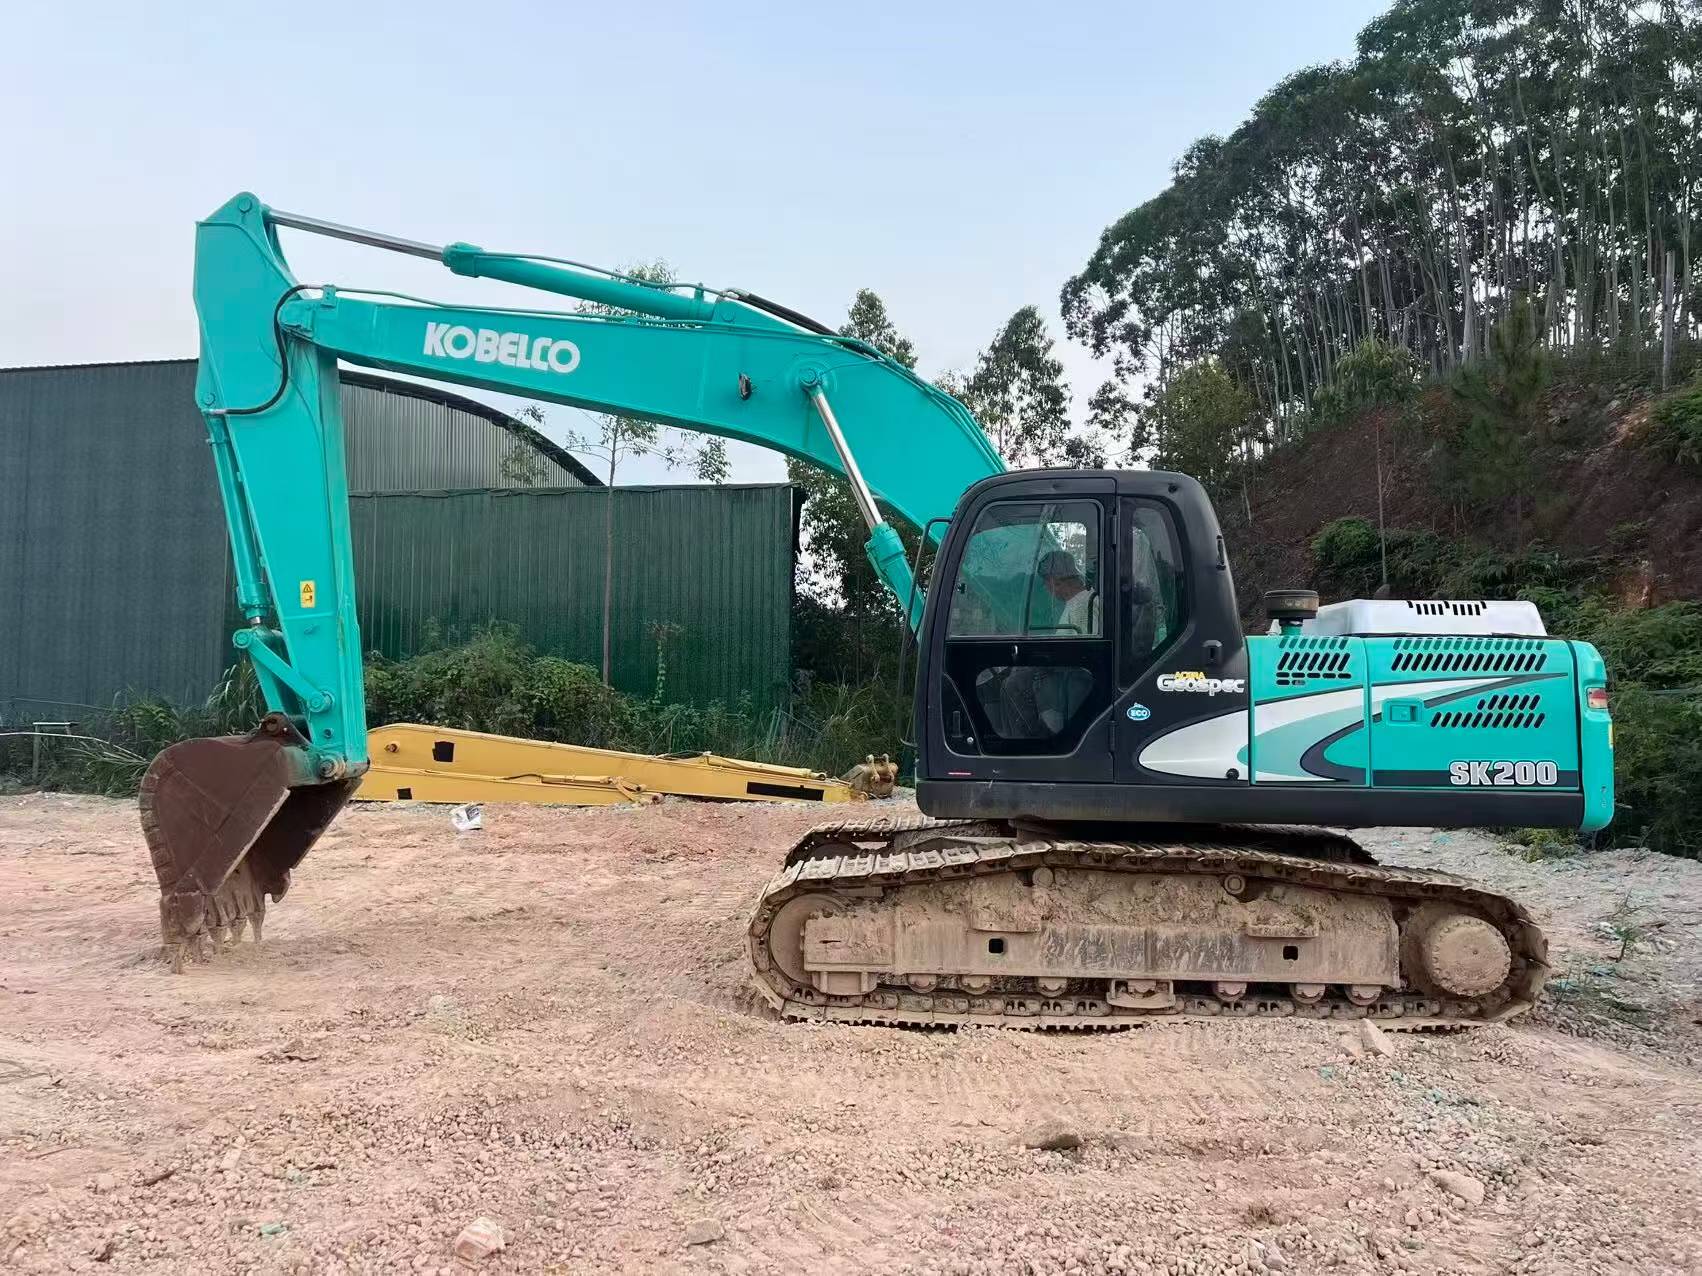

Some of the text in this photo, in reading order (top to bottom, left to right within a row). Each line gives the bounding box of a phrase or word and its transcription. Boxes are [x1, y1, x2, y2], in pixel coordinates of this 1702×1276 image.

[423, 321, 581, 373] KOBELCO
[1156, 674, 1245, 696] Geospec
[1130, 709, 1148, 717] ECO
[1449, 761, 1558, 786] SK200
